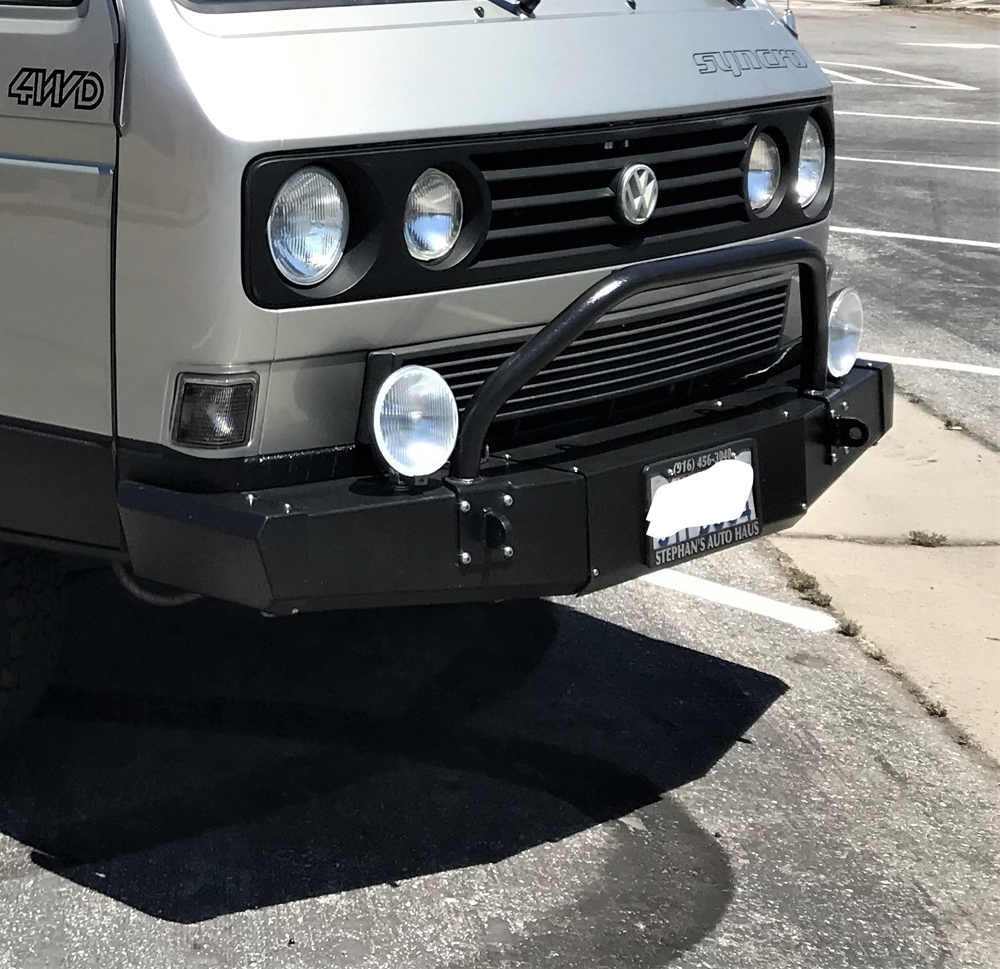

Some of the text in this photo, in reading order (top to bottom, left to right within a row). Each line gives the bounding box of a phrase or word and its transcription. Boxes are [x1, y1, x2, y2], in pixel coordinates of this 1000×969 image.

[693, 48, 808, 77] syncro
[8, 67, 104, 110] 4WD
[673, 458, 695, 476] (916)
[655, 537, 706, 565] STEPHAN'S
[707, 529, 733, 550] AUTO
[734, 520, 760, 541] HAUS
